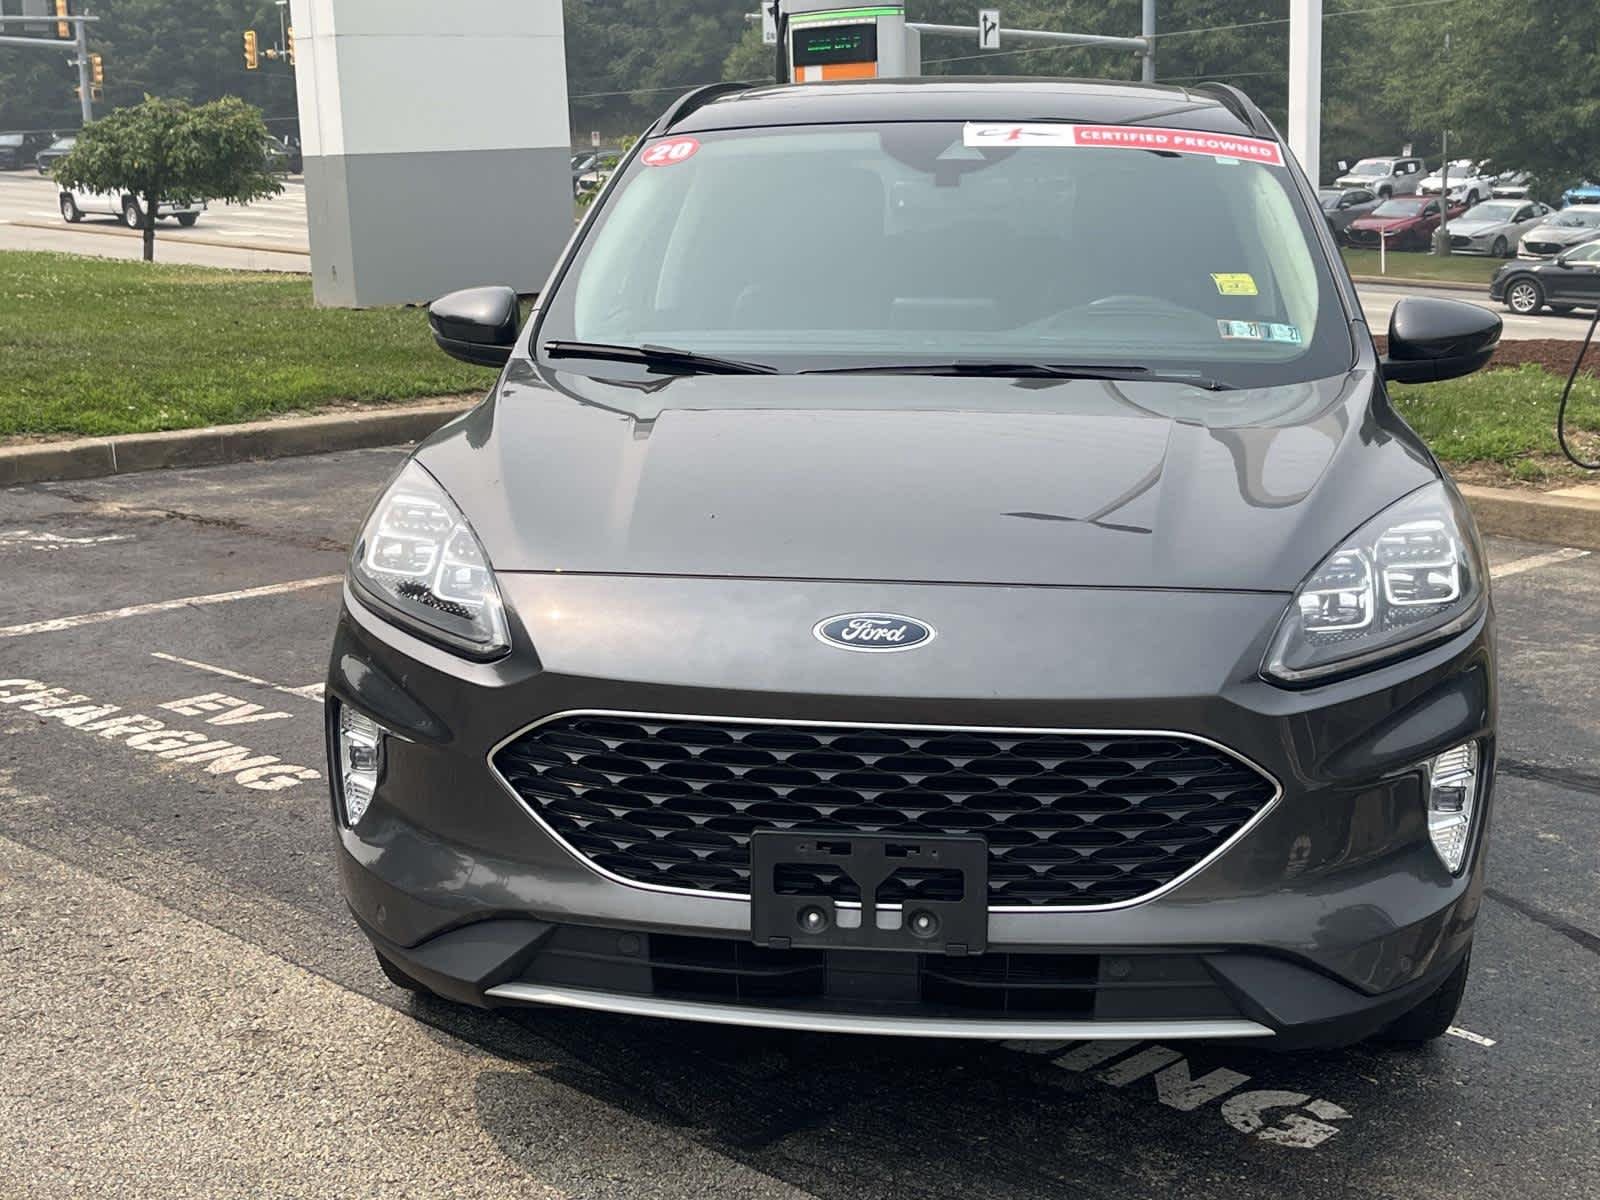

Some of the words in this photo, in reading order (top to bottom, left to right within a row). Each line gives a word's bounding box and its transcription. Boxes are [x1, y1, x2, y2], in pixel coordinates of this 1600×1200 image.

[646, 142, 693, 161] 20
[1080, 129, 1169, 144] CERTIFIED
[1173, 134, 1273, 157] PREOWNED
[841, 618, 908, 642] Ford
[157, 692, 294, 725] EV
[0, 678, 322, 791] CHARGING
